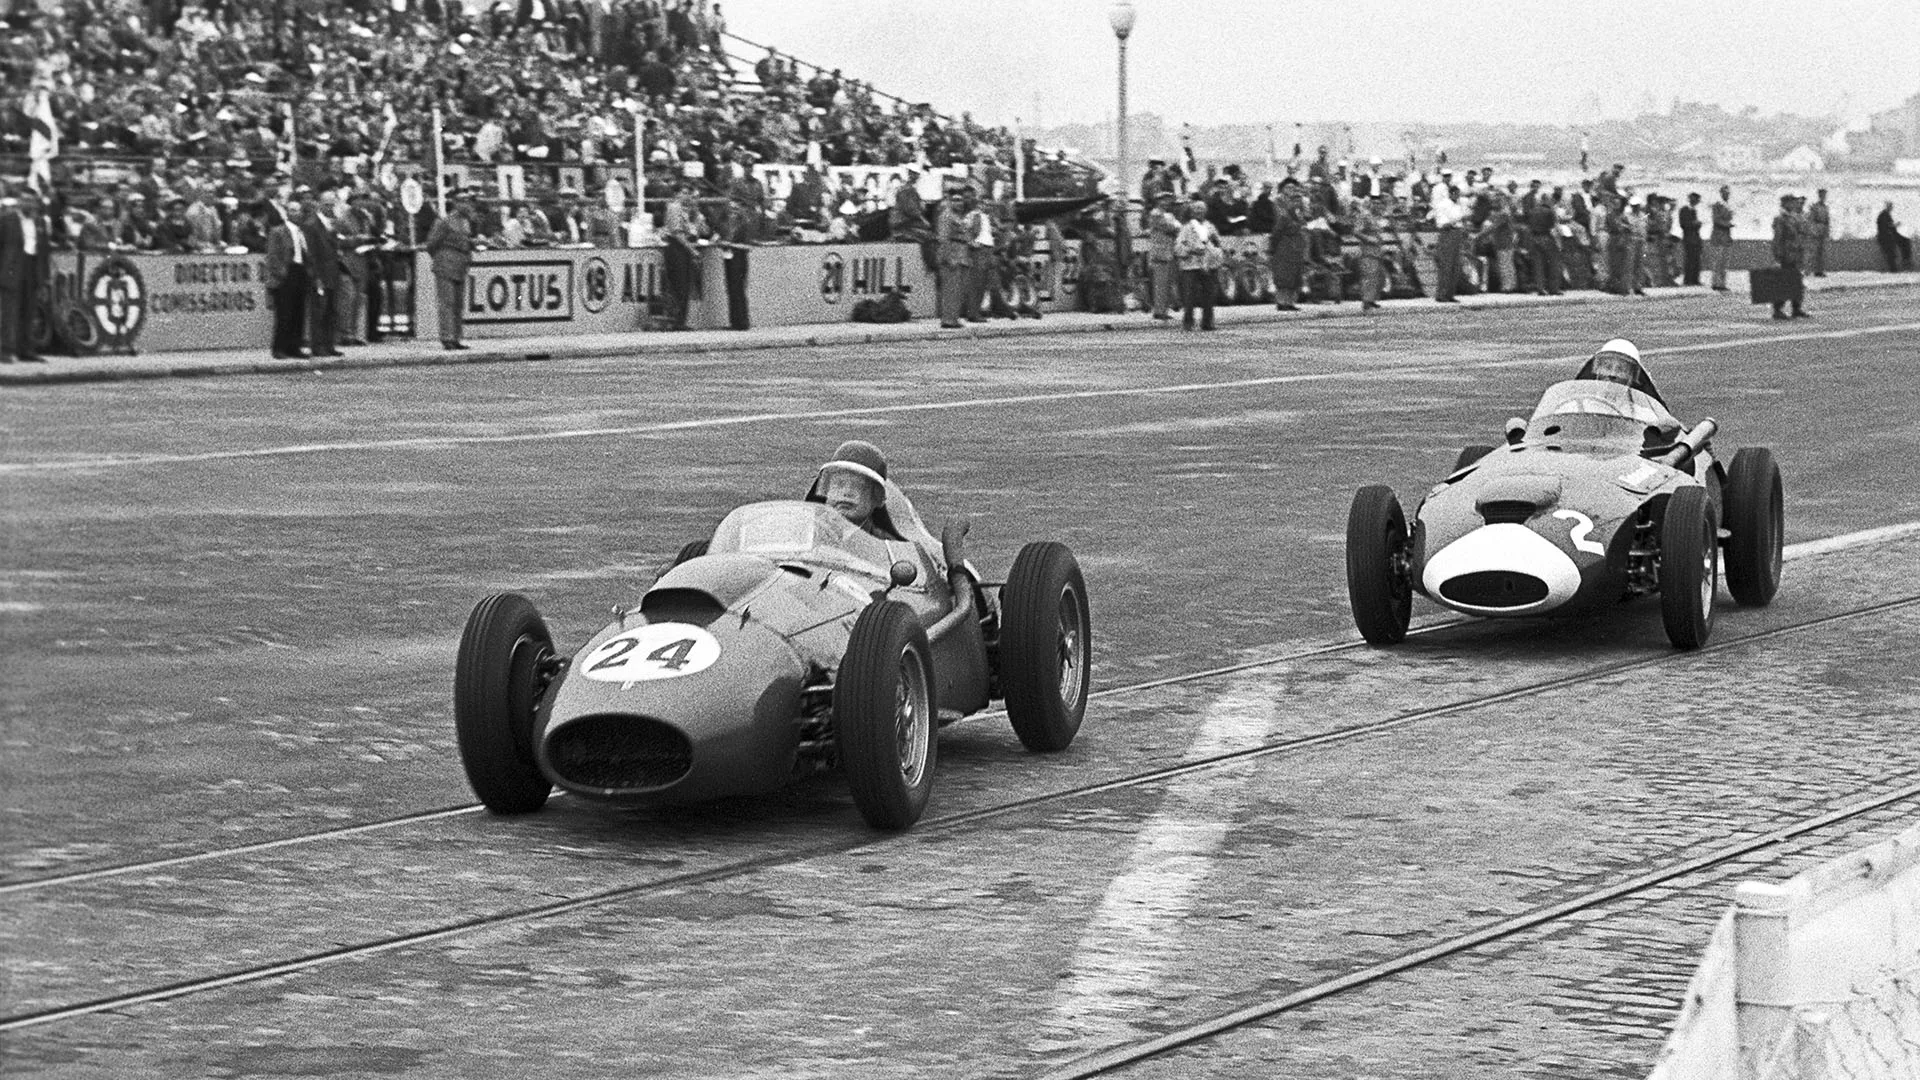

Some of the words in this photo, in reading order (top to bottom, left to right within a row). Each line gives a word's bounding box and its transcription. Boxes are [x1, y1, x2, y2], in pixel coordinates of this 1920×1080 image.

[174, 262, 251, 284] DIRECTOR
[586, 266, 606, 301] 18
[851, 257, 911, 294] HILL
[468, 273, 561, 312] LOTUS
[1553, 509, 1605, 556] 2
[589, 637, 697, 673] 24
